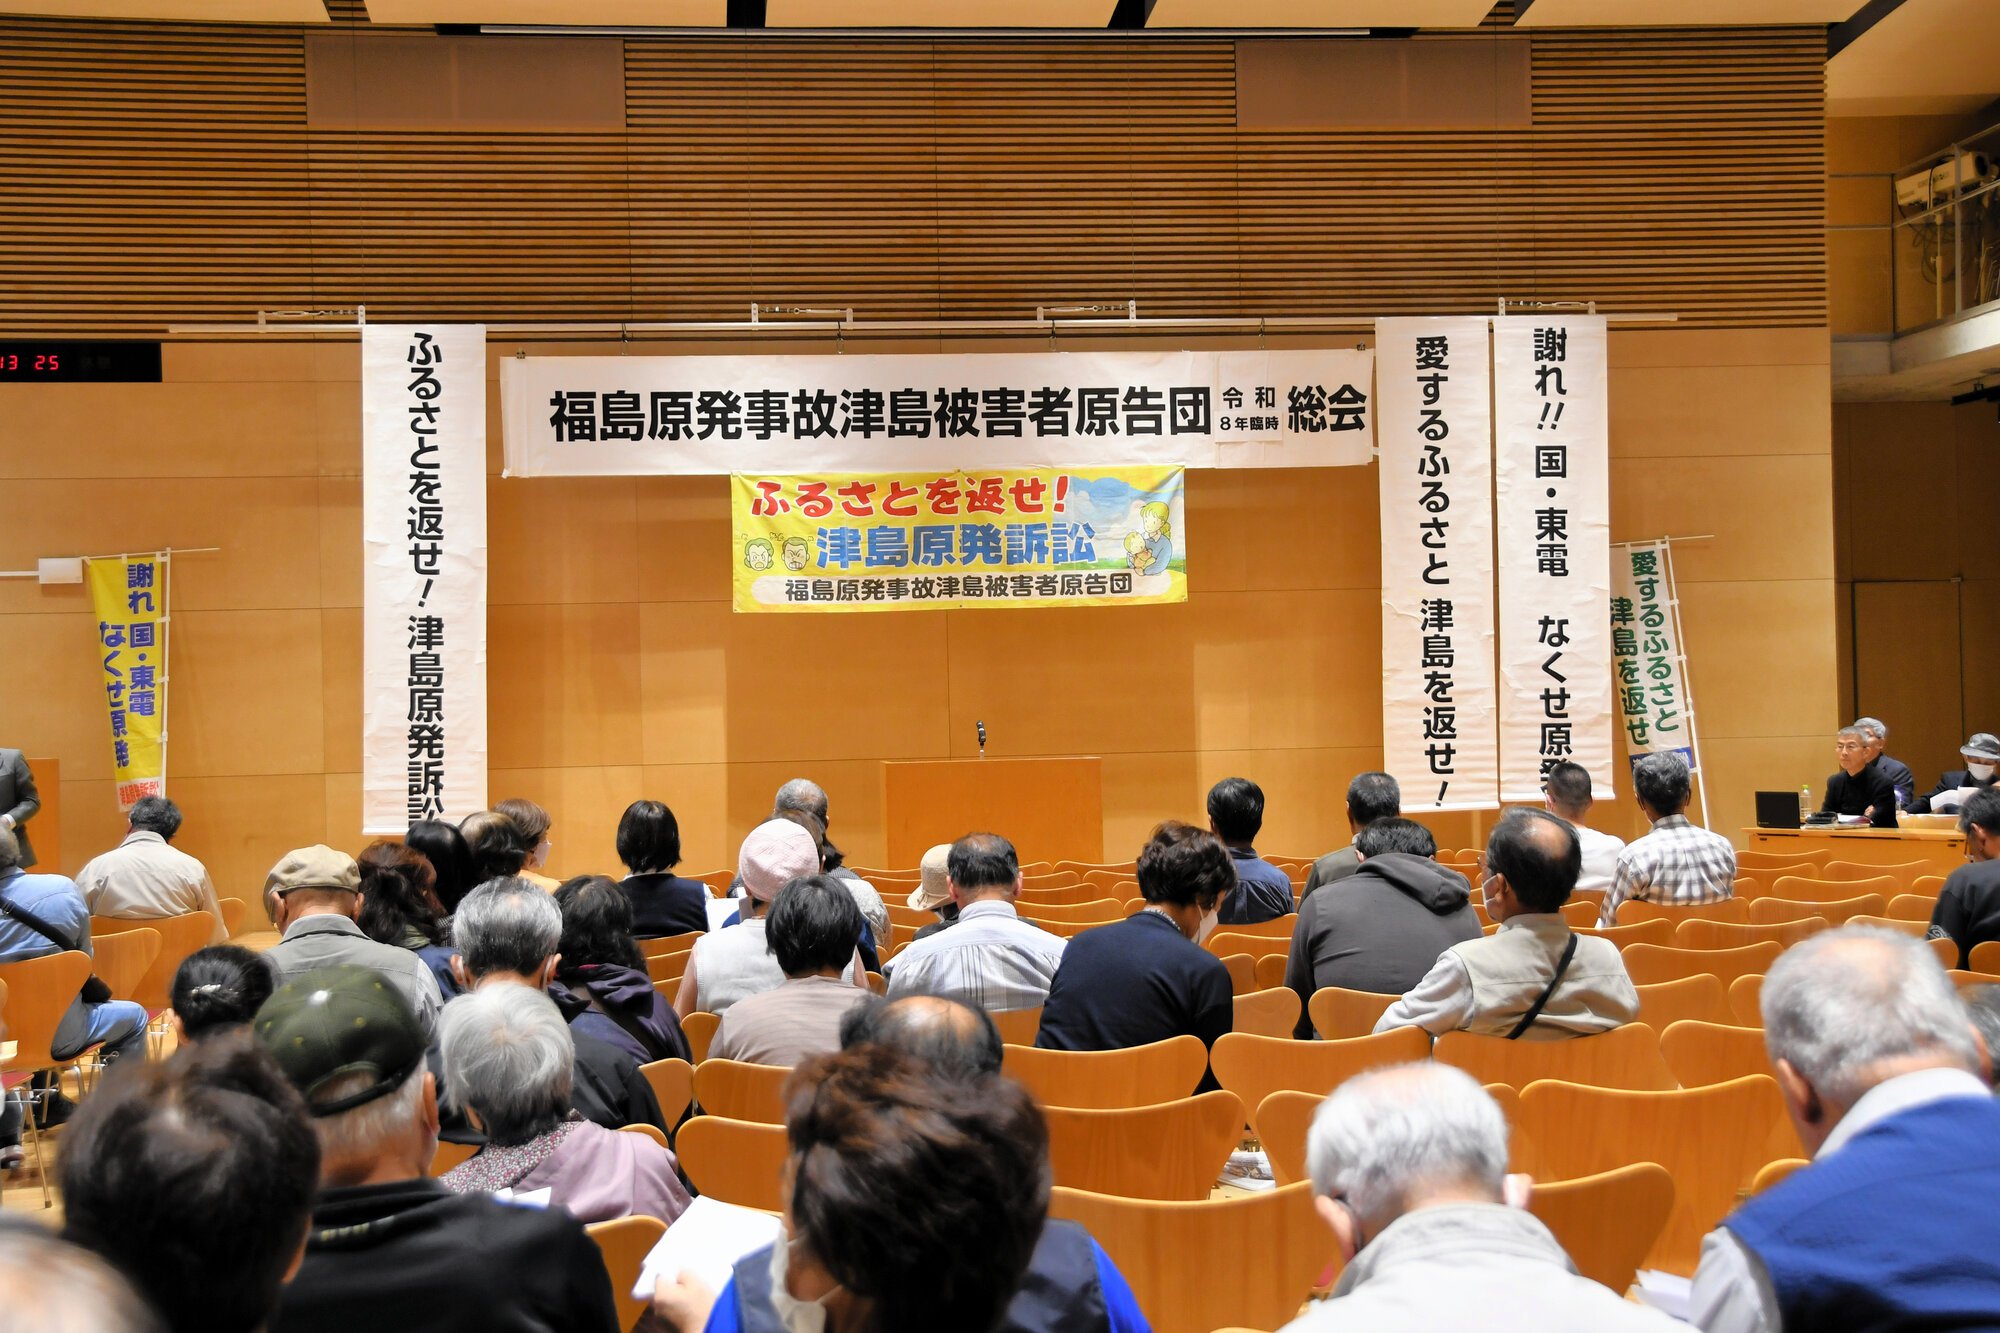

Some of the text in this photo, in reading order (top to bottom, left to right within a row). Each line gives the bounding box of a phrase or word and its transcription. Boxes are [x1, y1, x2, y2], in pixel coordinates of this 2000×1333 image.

[34, 355, 59, 370] 25
[1222, 386, 1276, 409] 令和
[549, 383, 1367, 442] 福島原発事故津島被害者原告団 総会
[1220, 415, 1279, 431] 8年臨時
[752, 475, 1068, 516] ふるさとを返せ！
[1534, 445, 1569, 577] 国・東電
[407, 332, 444, 827] ふるさとを返せ！津島原発訴訟
[785, 573, 1132, 601] 福島原発事故津島被害者原告団
[816, 523, 1096, 568] 津島原発訴訟
[1415, 335, 1456, 806] 愛するふるさと 津島を返せ！
[127, 563, 156, 716] 謝れ 国・東電
[1610, 596, 1650, 745] 津島を返せ
[1631, 551, 1679, 731] 愛するふるさと
[100, 621, 129, 768] なくせ原発
